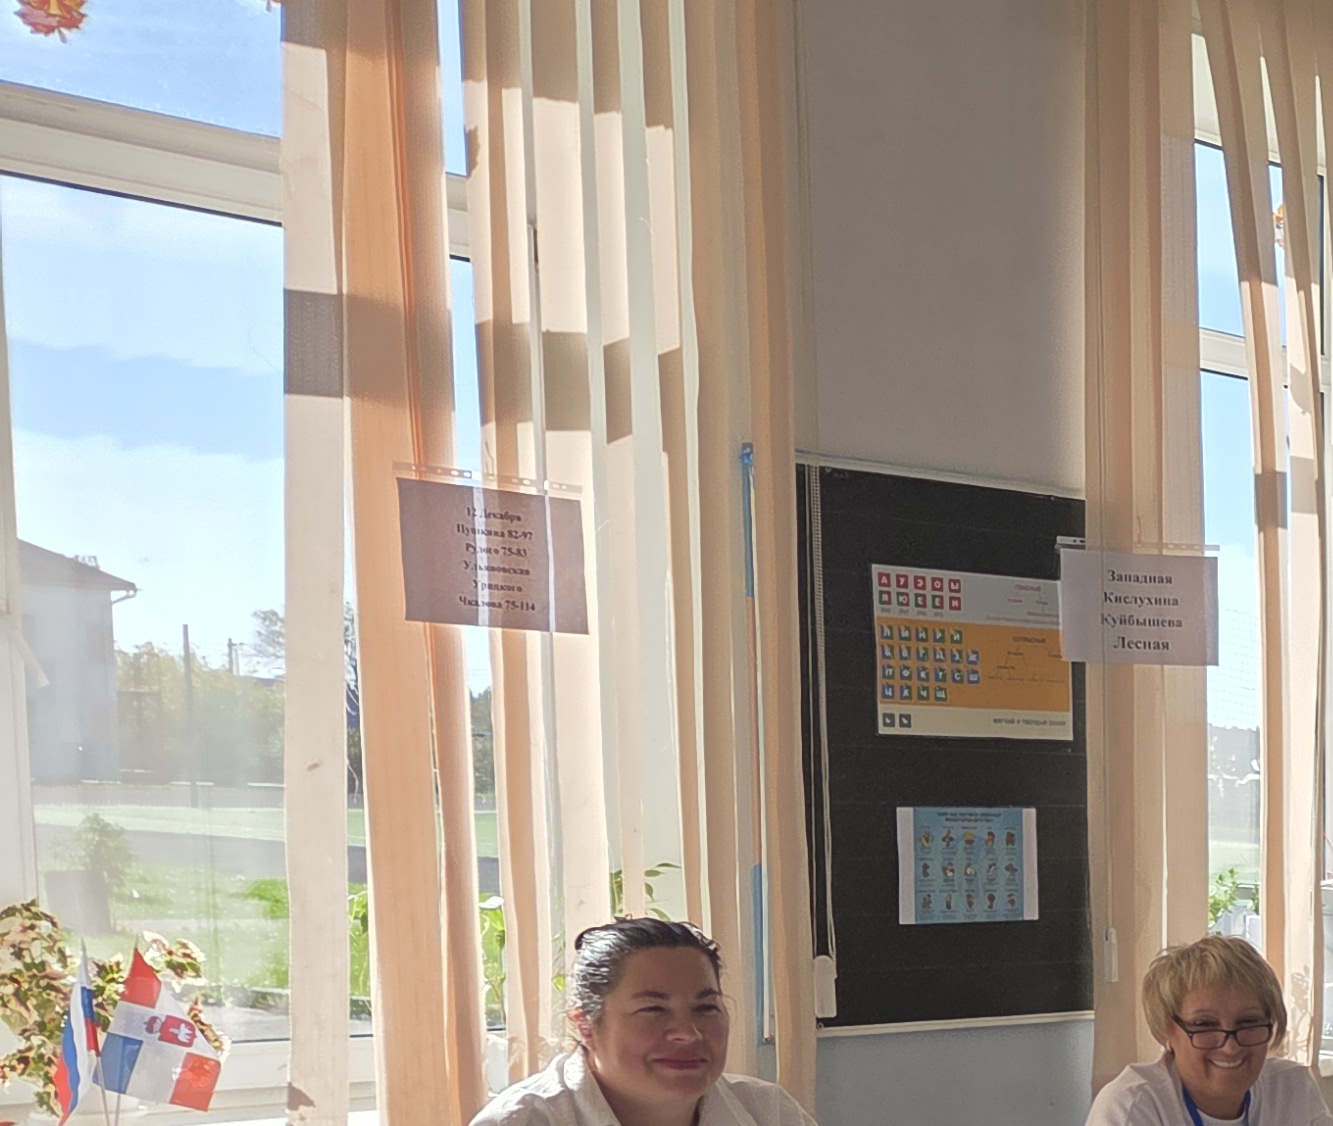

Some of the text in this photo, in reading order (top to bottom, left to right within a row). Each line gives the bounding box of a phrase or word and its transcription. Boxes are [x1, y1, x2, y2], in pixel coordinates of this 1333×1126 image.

[507, 530, 533, 541] 82-97
[1107, 569, 1173, 584] Западная
[505, 600, 536, 611] 75-114
[1103, 592, 1179, 608] Кислухина
[1101, 612, 1183, 628] Куйбышева
[1113, 636, 1170, 651] Лесная
